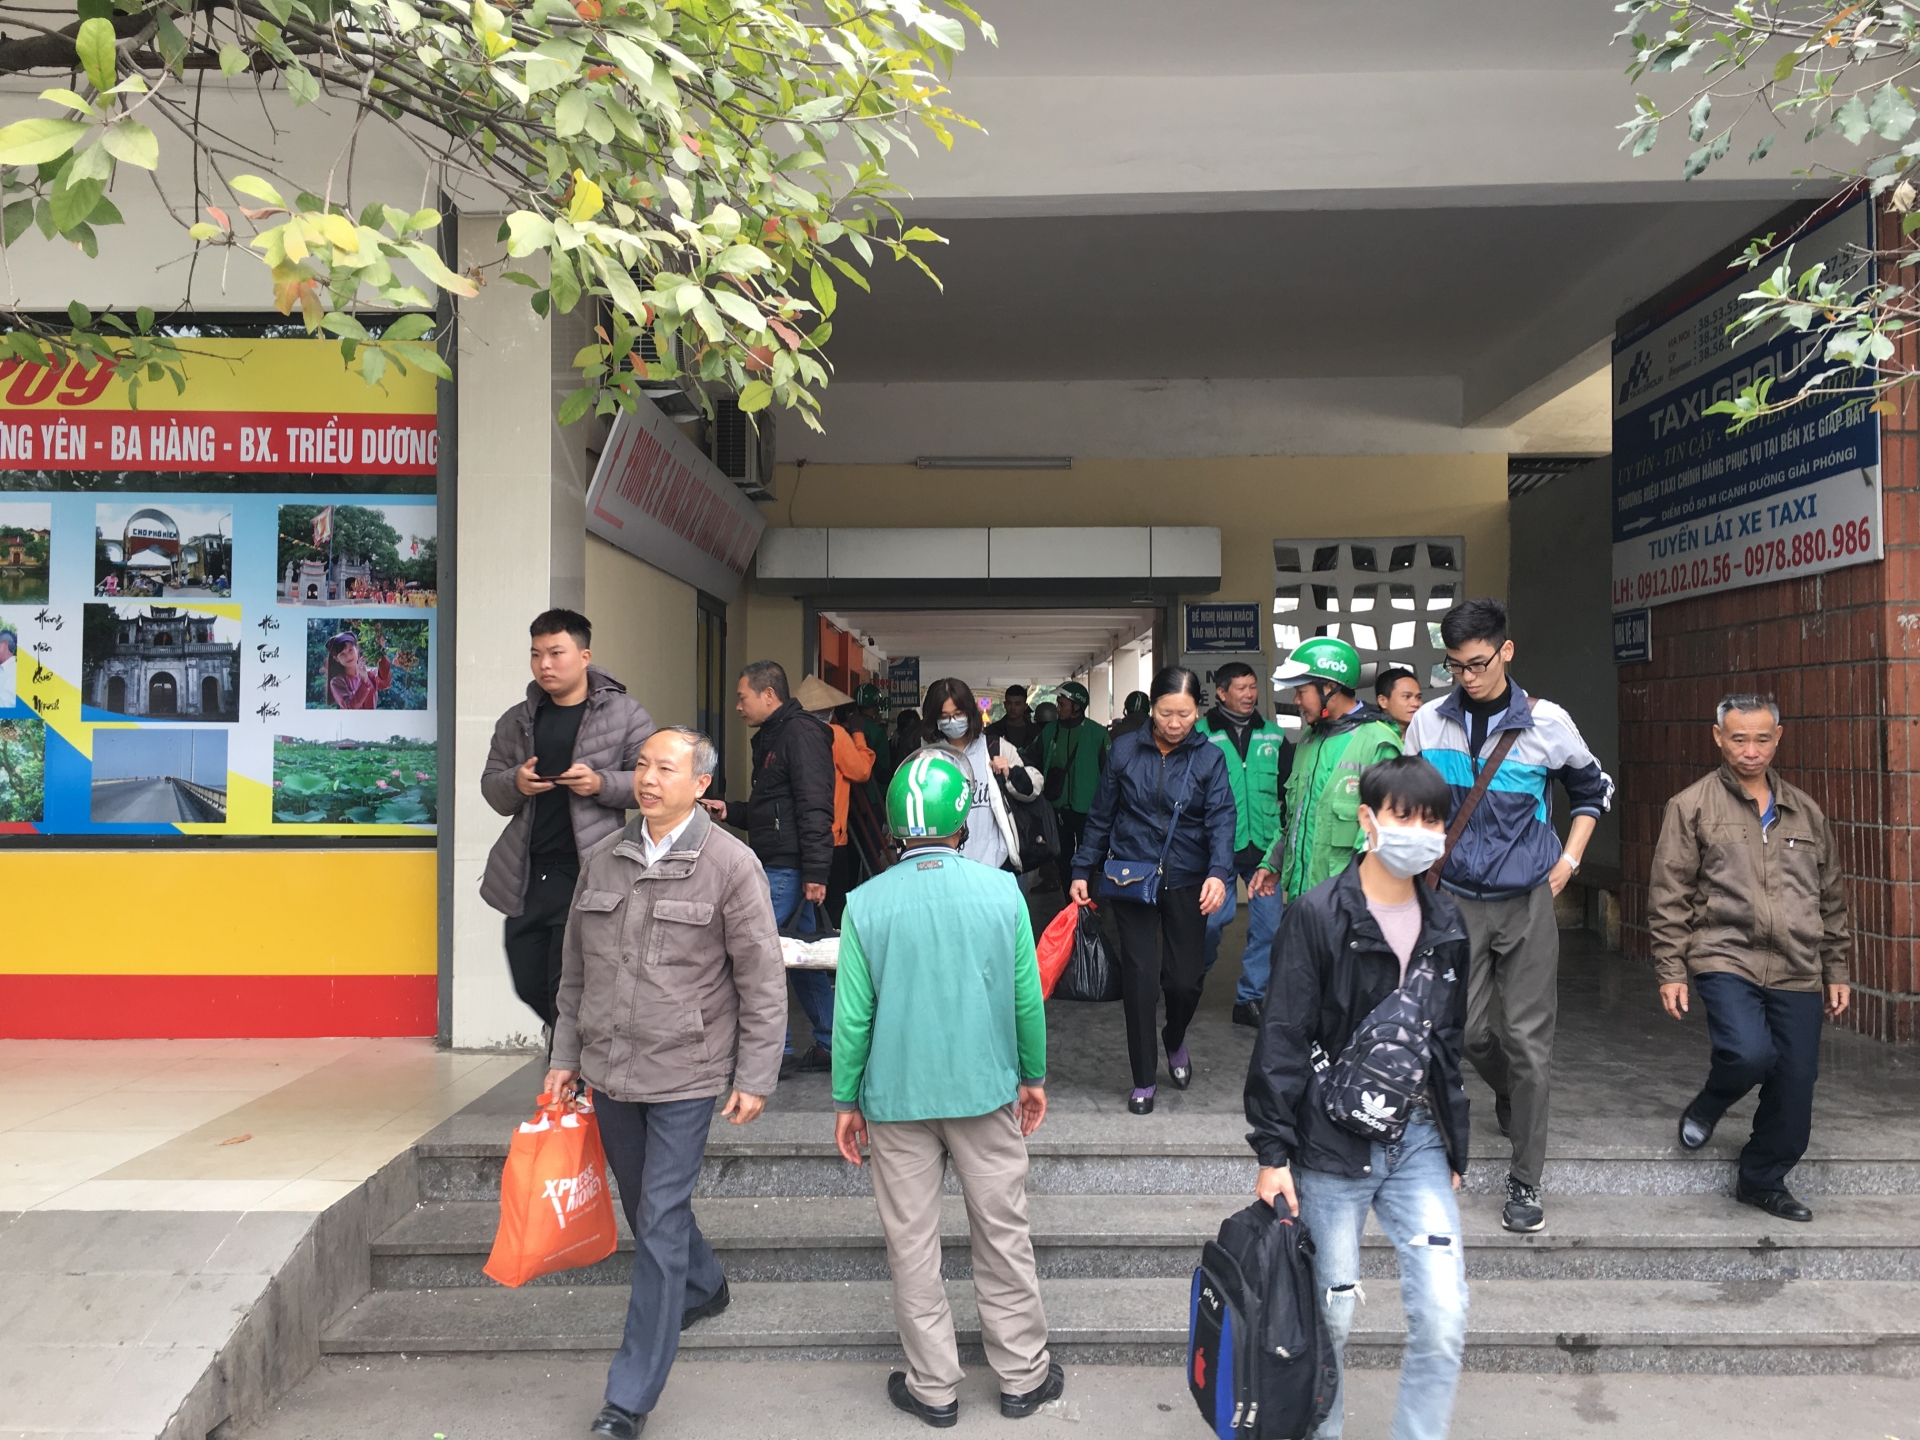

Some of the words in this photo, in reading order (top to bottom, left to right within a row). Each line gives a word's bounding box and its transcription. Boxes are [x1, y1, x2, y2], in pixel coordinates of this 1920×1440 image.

[0, 420, 33, 461] NG
[41, 416, 87, 460] YÊN
[111, 425, 143, 461] BA
[150, 418, 216, 462] HÀNG
[240, 426, 278, 463] BX.
[286, 415, 354, 463] TRIỀU
[1802, 421, 1816, 445] XE
[1708, 496, 1717, 506] M
[1648, 523, 1699, 561] TUYỂN
[1704, 513, 1733, 547] LÁI
[1738, 509, 1762, 538] XE
[1766, 493, 1818, 529] TAXI
[1613, 576, 1634, 605] LH:
[1637, 551, 1732, 600] 0912.02.02.56
[1744, 515, 1871, 578] 0978.880.986
[1316, 657, 1348, 673] Grab
[1351, 1109, 1387, 1132] adidas
